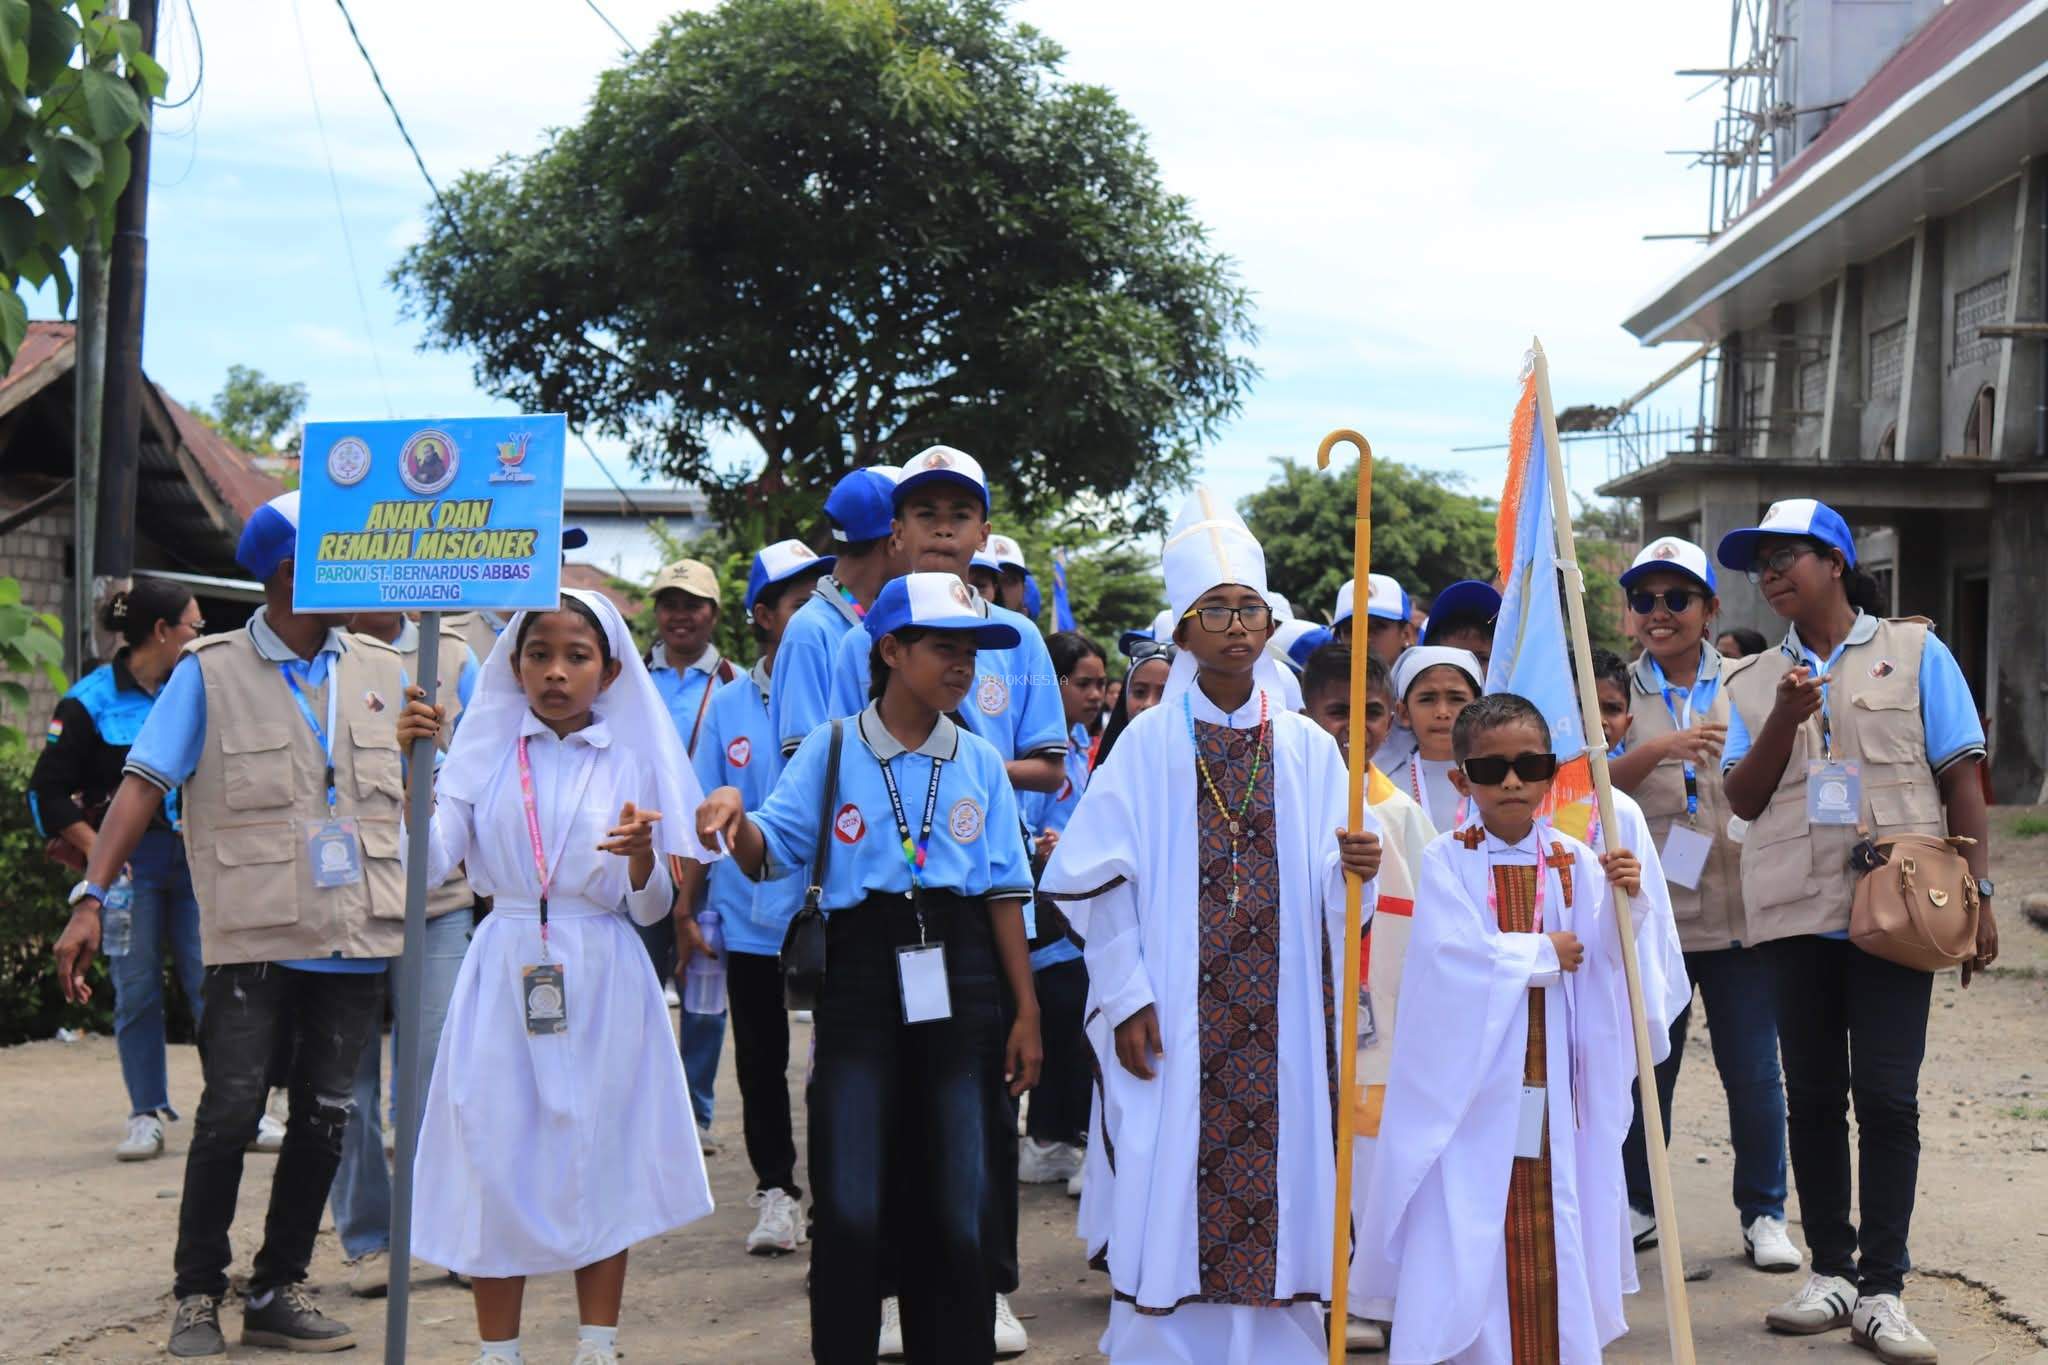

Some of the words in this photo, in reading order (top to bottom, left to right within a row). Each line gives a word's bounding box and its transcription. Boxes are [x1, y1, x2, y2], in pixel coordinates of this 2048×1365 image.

[366, 501, 437, 529] ANAK
[436, 499, 493, 529] DAN
[317, 531, 414, 560] REMAJA
[413, 529, 538, 560] MISIONER
[317, 566, 367, 581] PAROKI
[369, 566, 390, 580] ST.
[392, 565, 480, 580] BERNARDUS
[481, 563, 531, 580] ABBAS
[381, 583, 461, 600] TOKOJAENG
